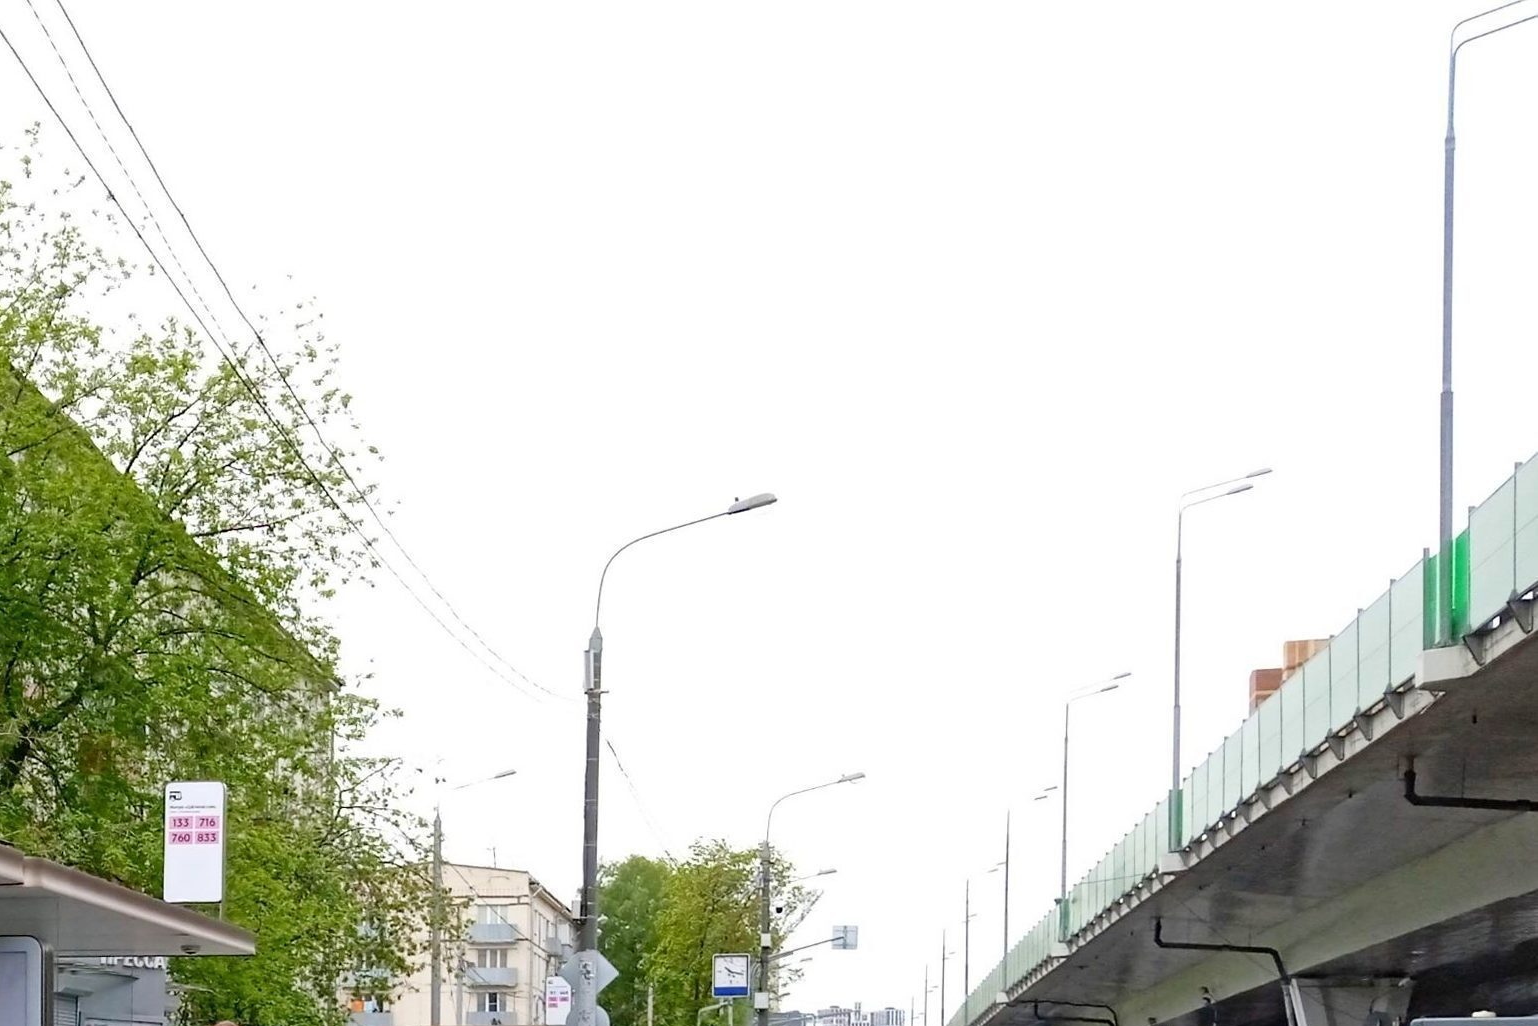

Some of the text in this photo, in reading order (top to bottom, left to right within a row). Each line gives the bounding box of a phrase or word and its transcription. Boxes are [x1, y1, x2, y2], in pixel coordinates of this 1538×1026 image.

[173, 818, 216, 827] 133 716
[172, 833, 216, 843] 760 833
